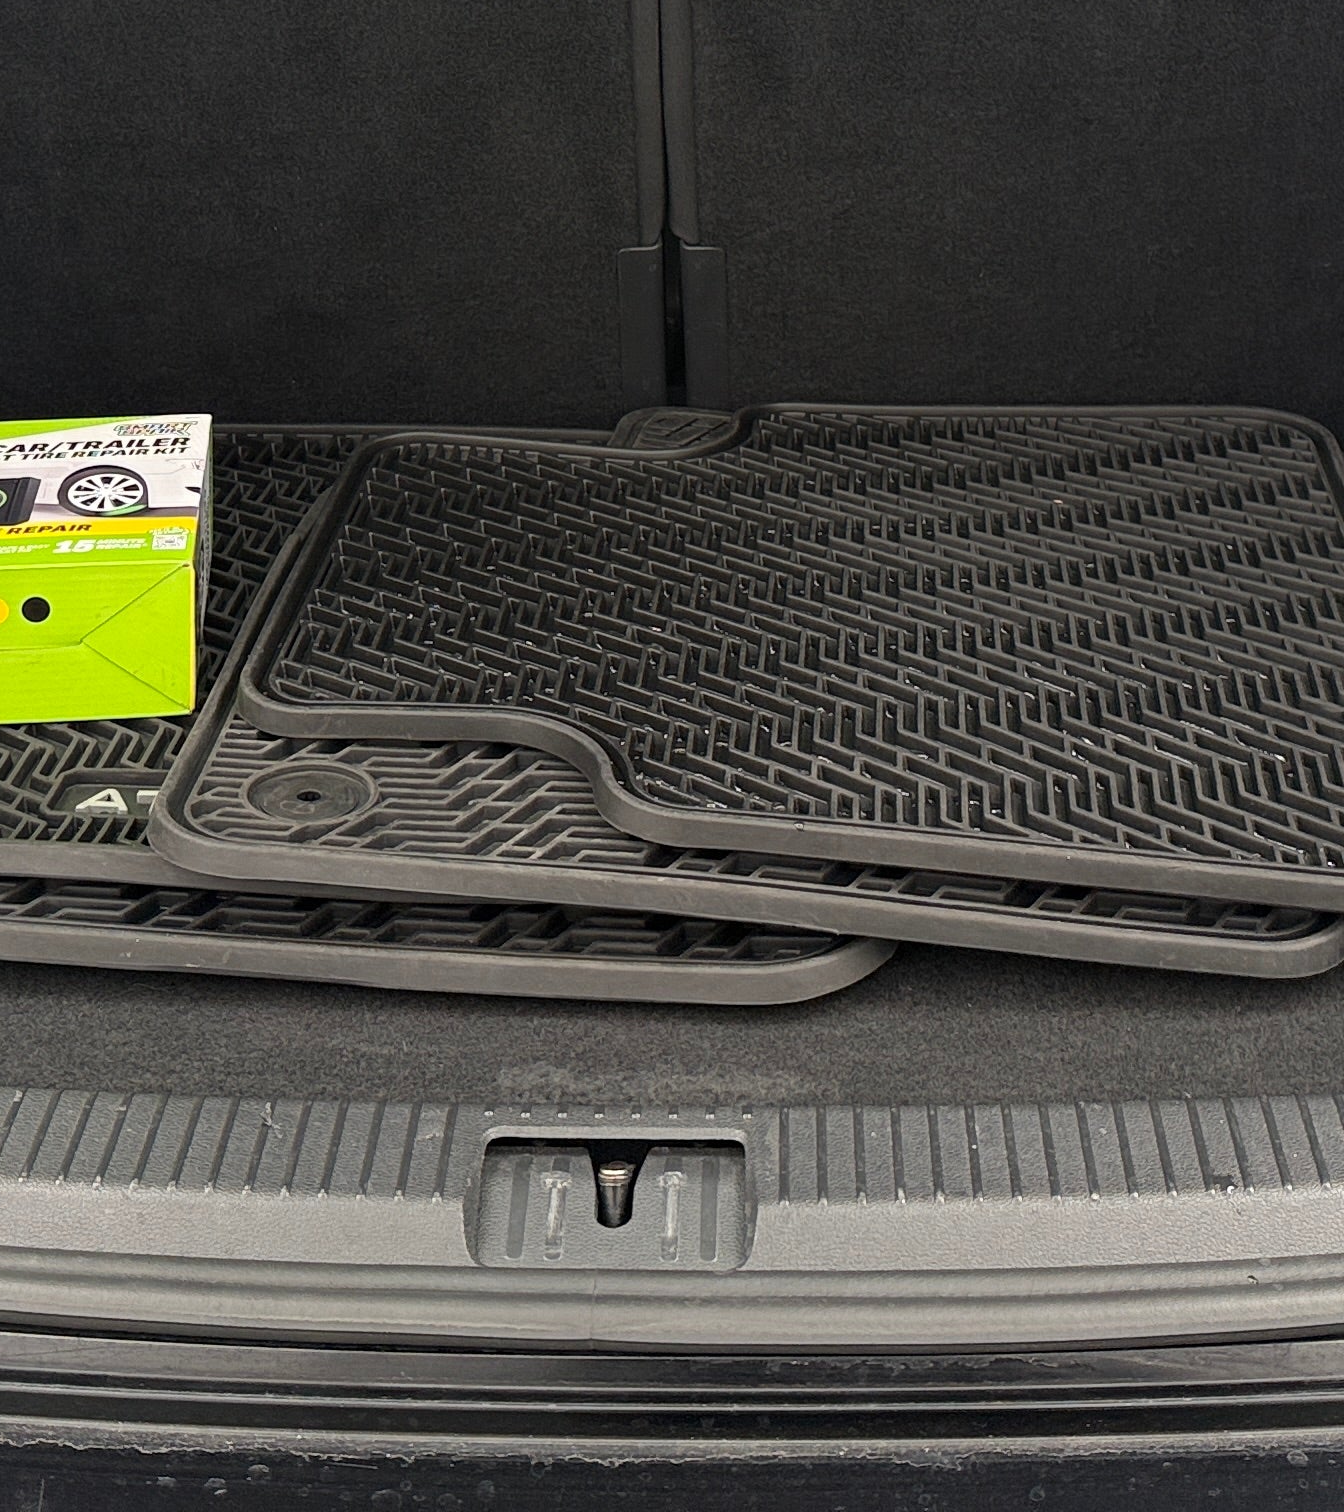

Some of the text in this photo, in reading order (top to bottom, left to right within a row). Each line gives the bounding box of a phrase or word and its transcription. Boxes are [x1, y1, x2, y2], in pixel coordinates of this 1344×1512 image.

[22, 451, 66, 461] TIRE
[71, 448, 148, 458] REPAIR
[155, 447, 190, 455] KIT
[7, 524, 92, 534] REPAIR
[53, 539, 96, 554] 15
